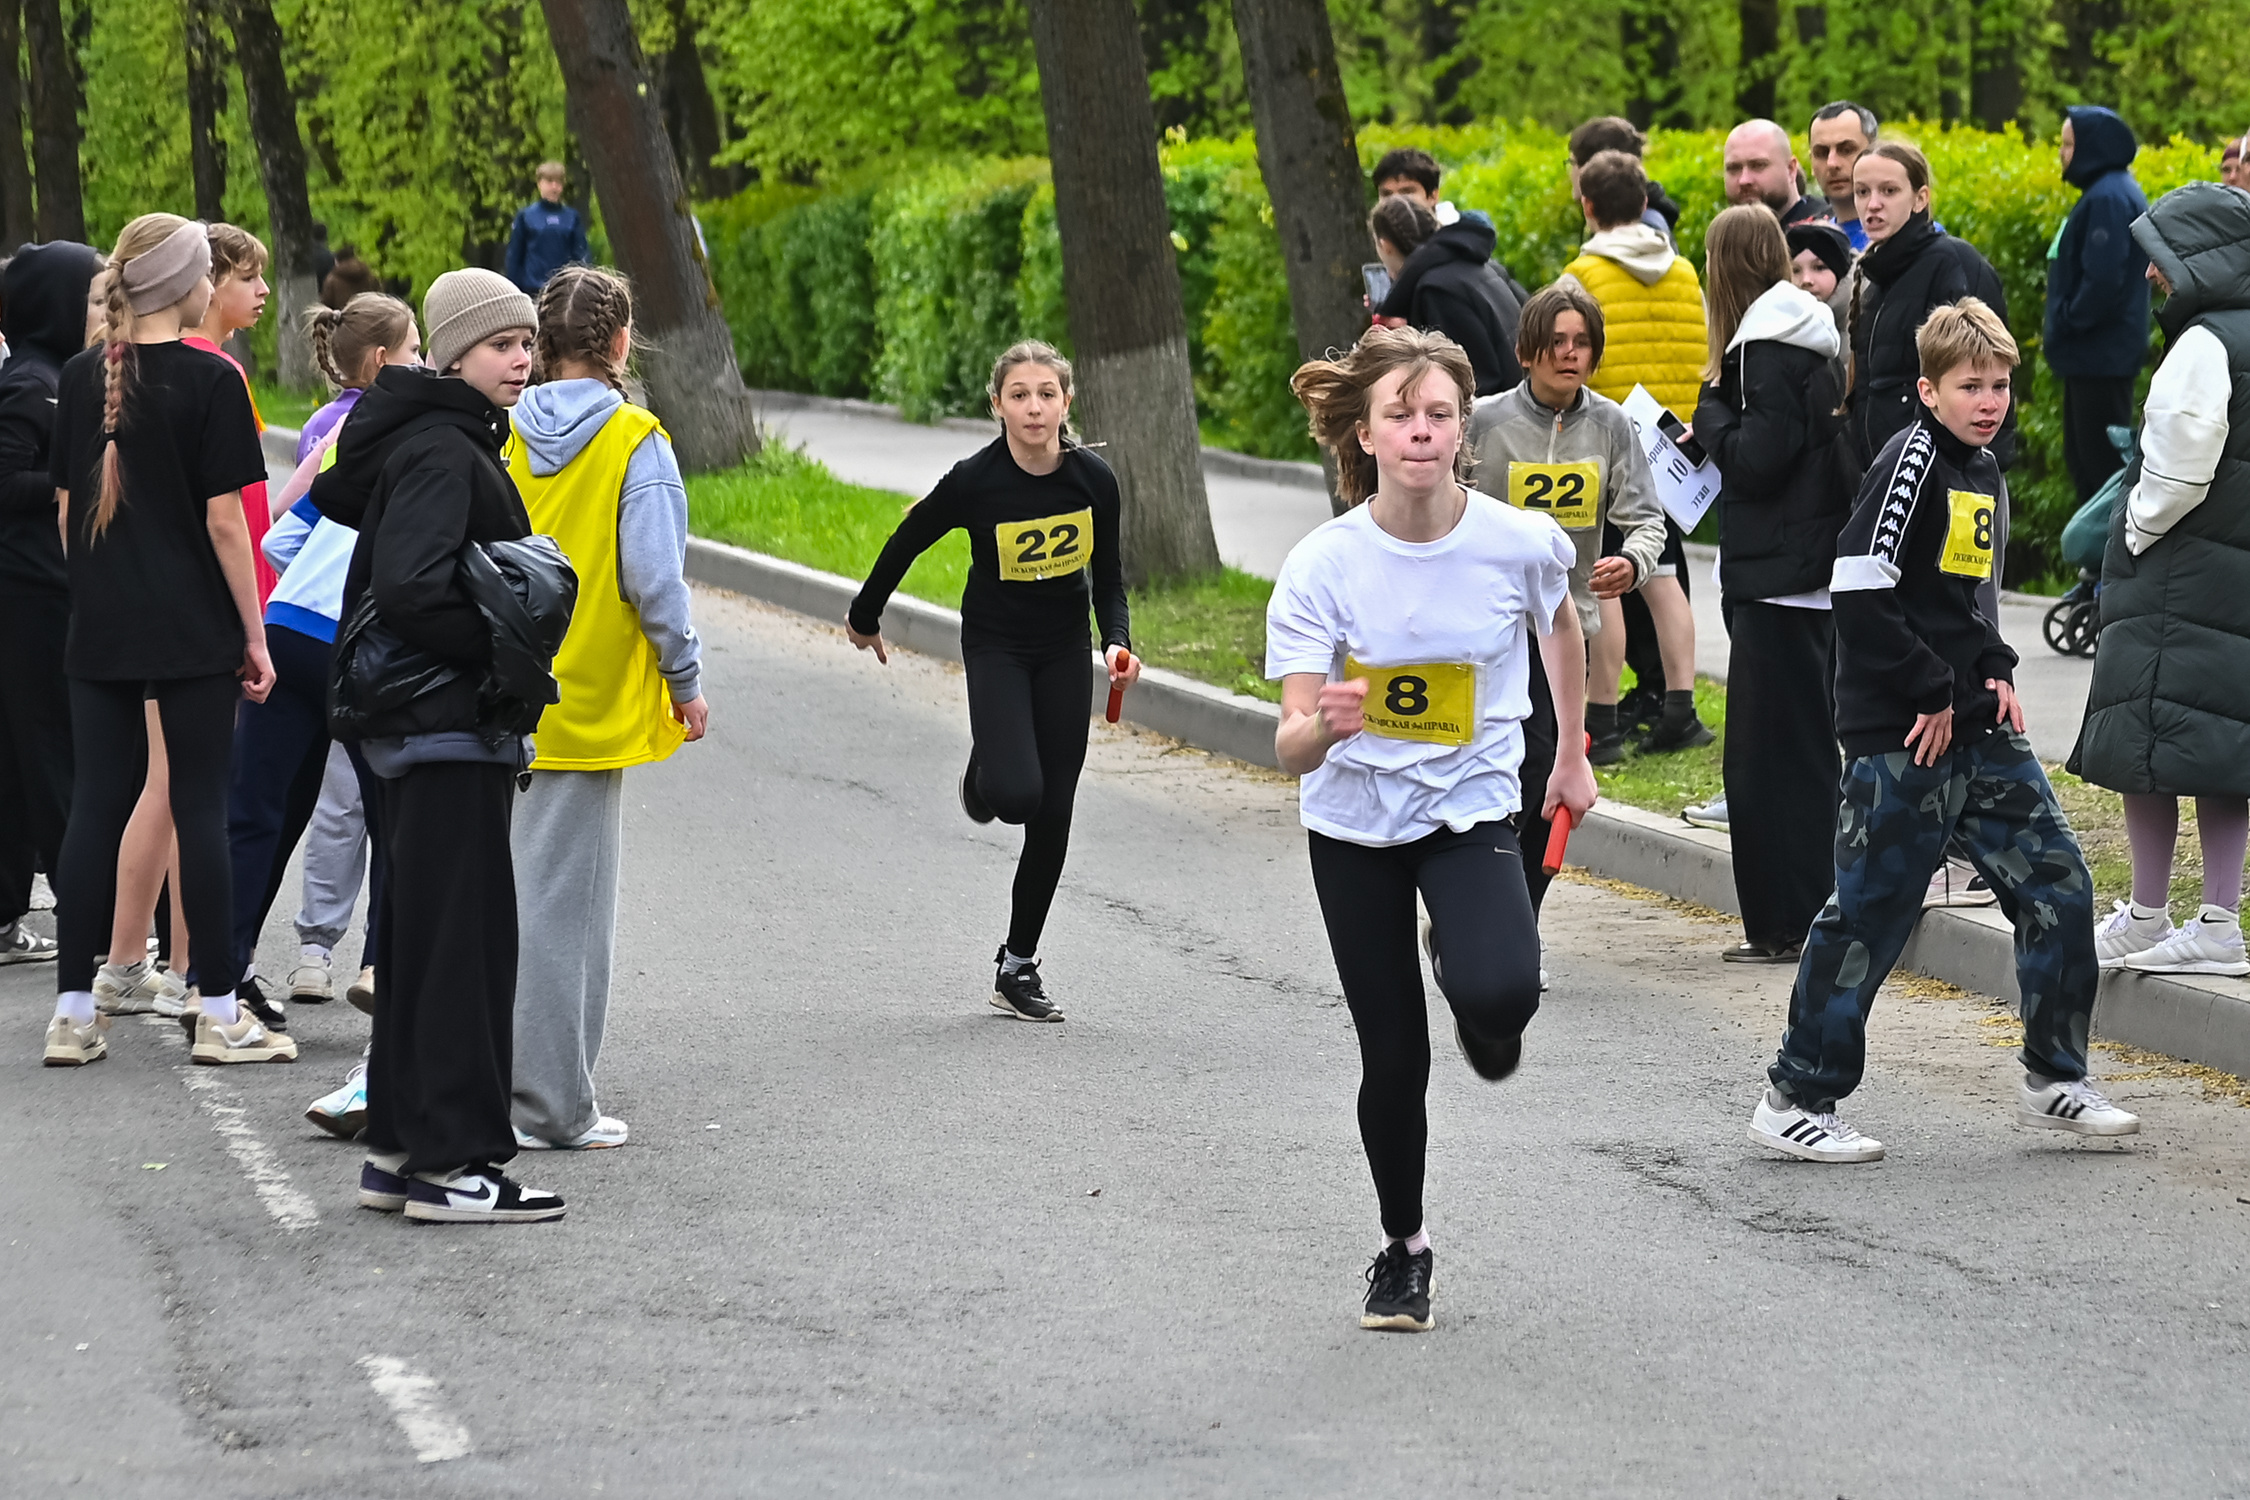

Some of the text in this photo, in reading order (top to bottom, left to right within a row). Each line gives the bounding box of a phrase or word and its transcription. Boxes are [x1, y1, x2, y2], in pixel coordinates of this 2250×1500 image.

[1666, 457, 1689, 486] 10
[1523, 472, 1585, 509] 22
[1690, 484, 1710, 509] этап
[1015, 523, 1079, 564] 22
[1973, 507, 1993, 550] 8
[1384, 674, 1430, 716] 8
[1363, 713, 1461, 733] СКОВСКАЯ ПРАВДА
